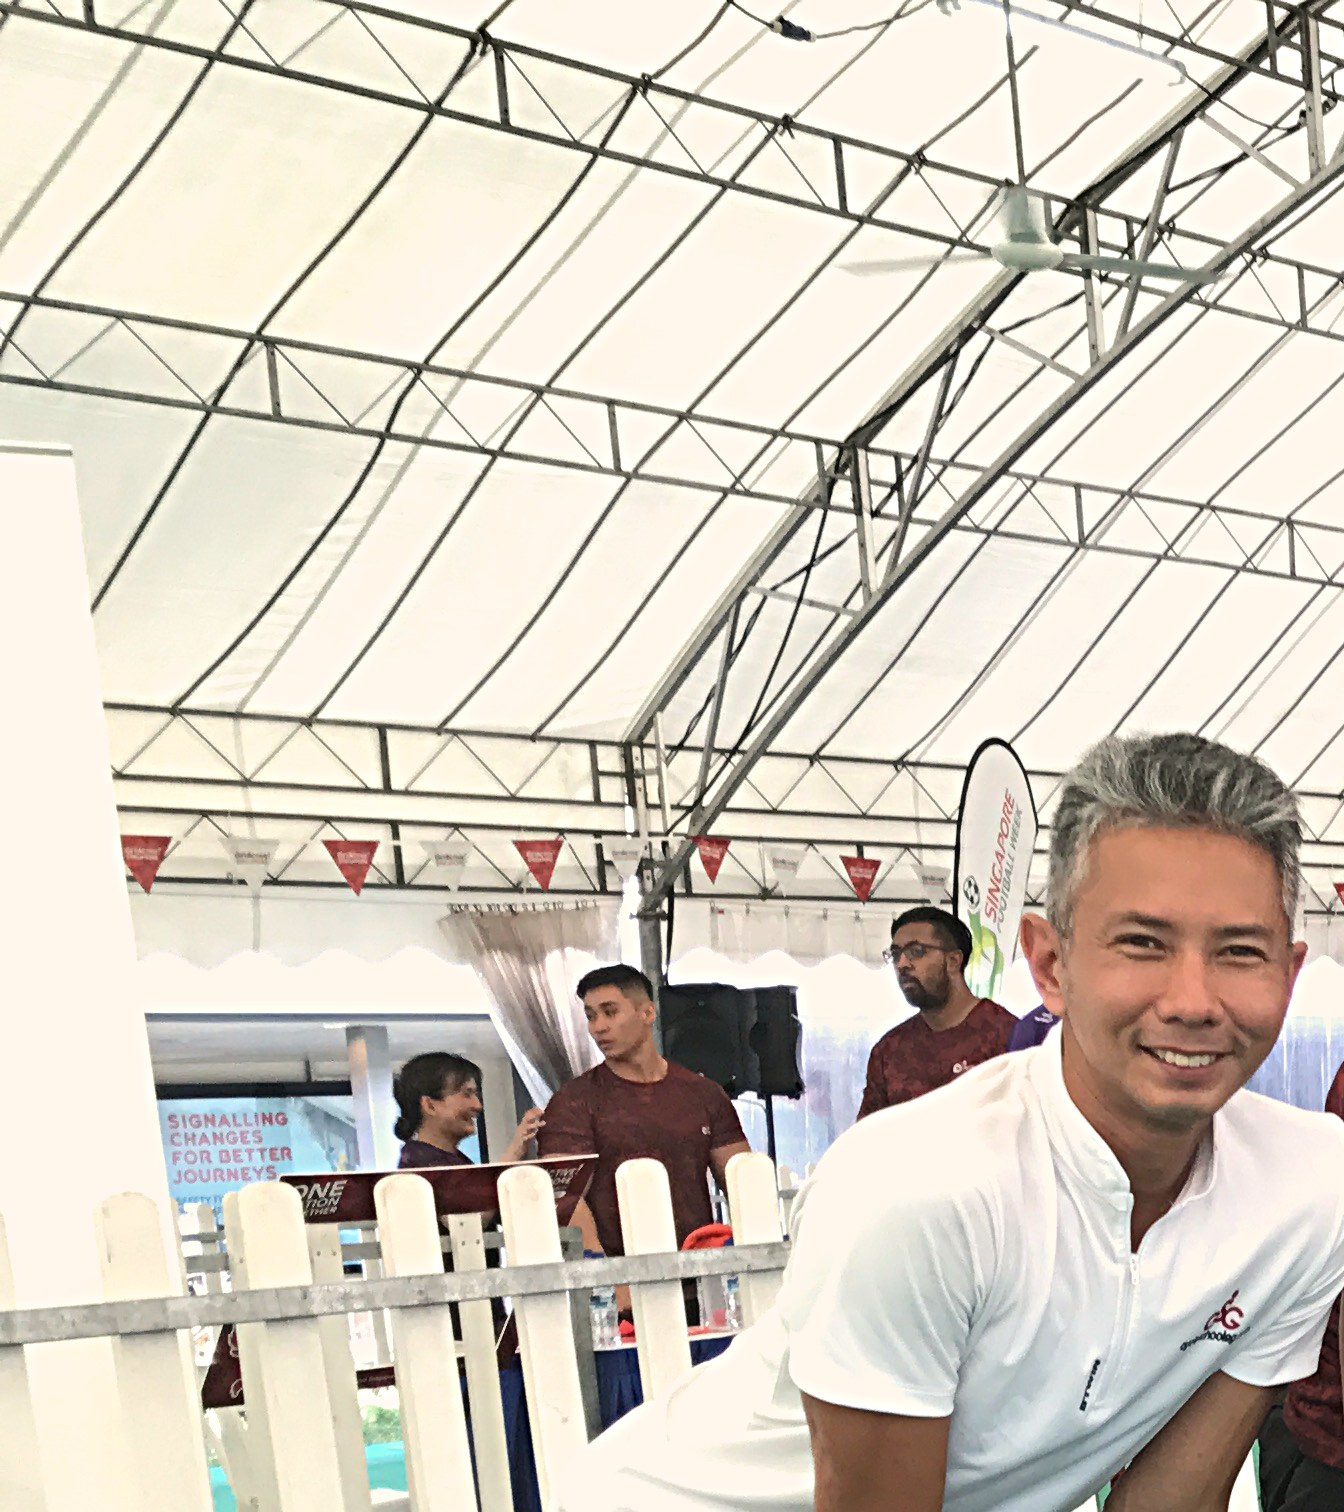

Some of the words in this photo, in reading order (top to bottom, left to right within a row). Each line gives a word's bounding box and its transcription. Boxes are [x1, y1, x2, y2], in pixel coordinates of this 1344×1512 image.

[1010, 802, 1022, 850] WEEK
[985, 787, 1015, 923] SINGAPORE
[167, 1112, 289, 1130] SIGNALLING
[170, 1130, 264, 1147] CHANGES
[172, 1149, 212, 1166] FOR
[219, 1146, 293, 1164] BETTER
[173, 1165, 279, 1185] JOURNEYS
